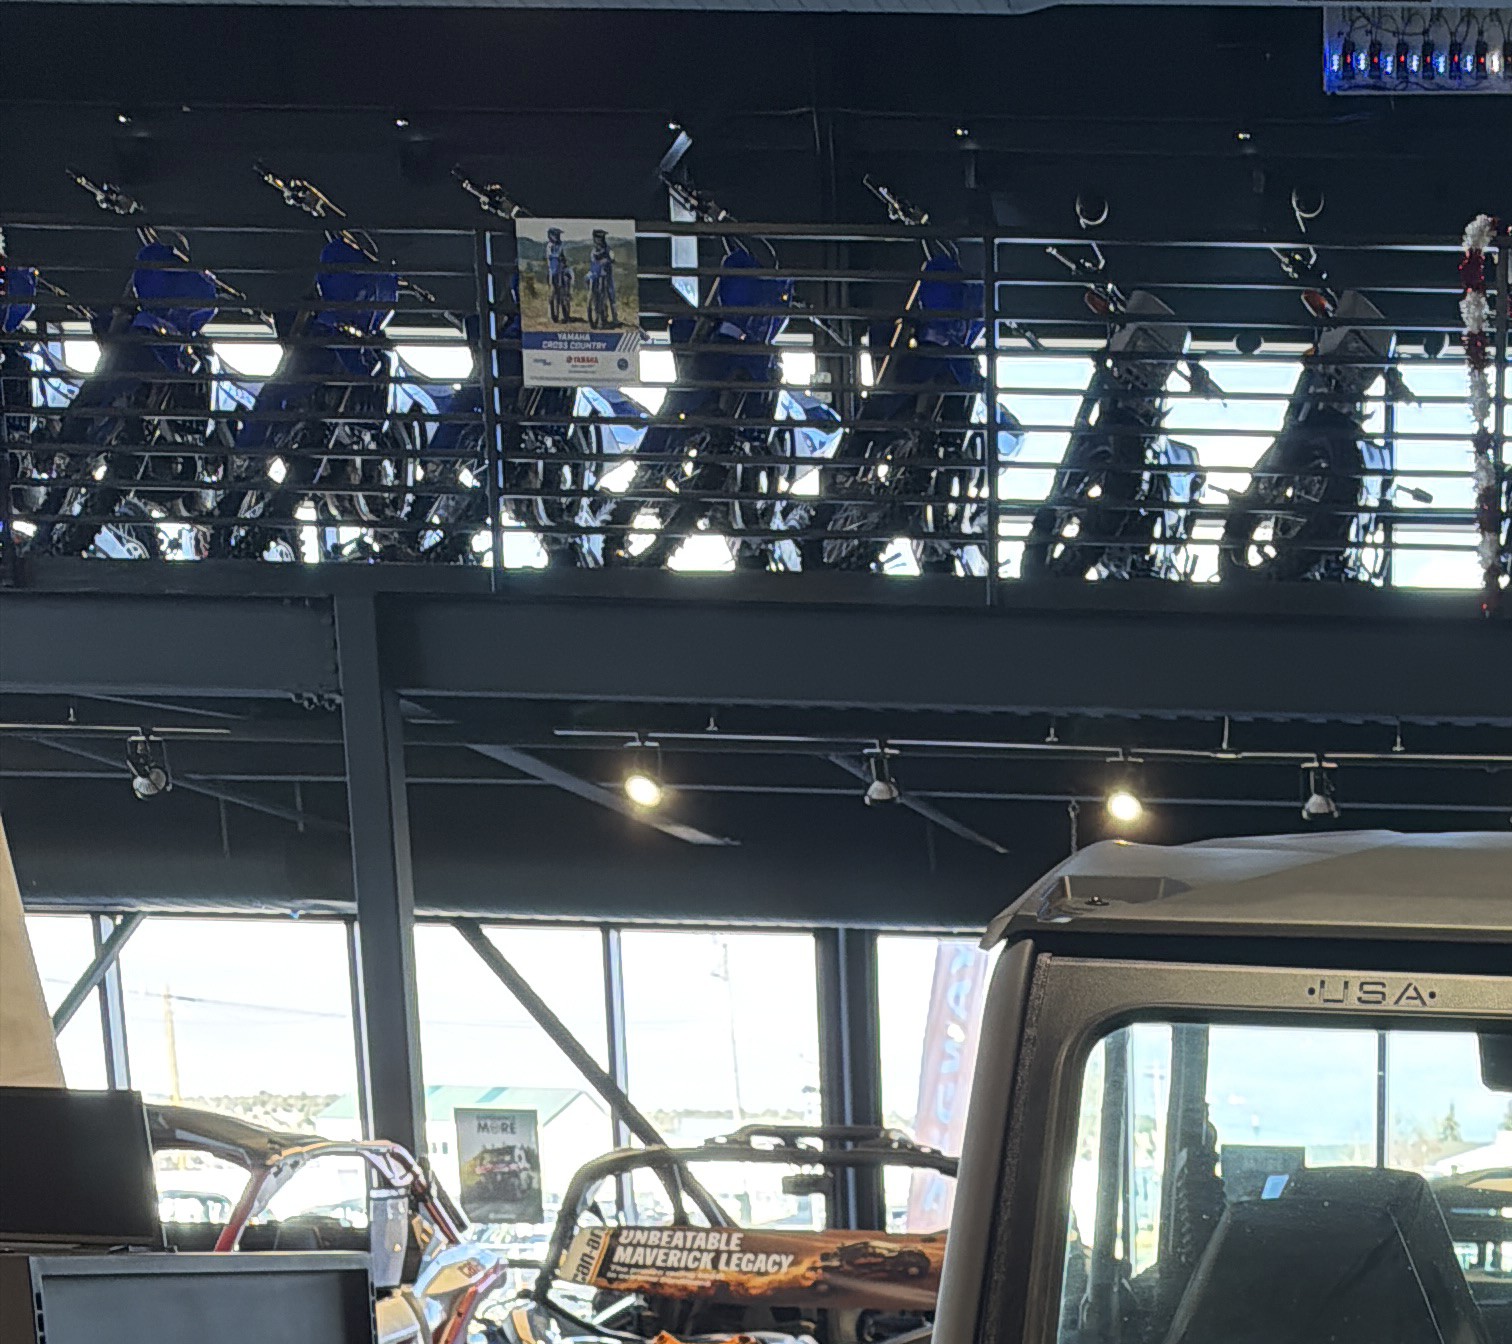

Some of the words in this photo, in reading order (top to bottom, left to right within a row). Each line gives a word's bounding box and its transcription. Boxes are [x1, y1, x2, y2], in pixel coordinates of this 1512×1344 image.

[542, 341, 567, 349] CROSS
[570, 342, 606, 350] COUNTRY
[1319, 979, 1428, 1007] USA
[618, 1229, 744, 1251] UNBEATABLE
[612, 1246, 716, 1270] MAVERICK
[718, 1252, 795, 1273] LEGACY
